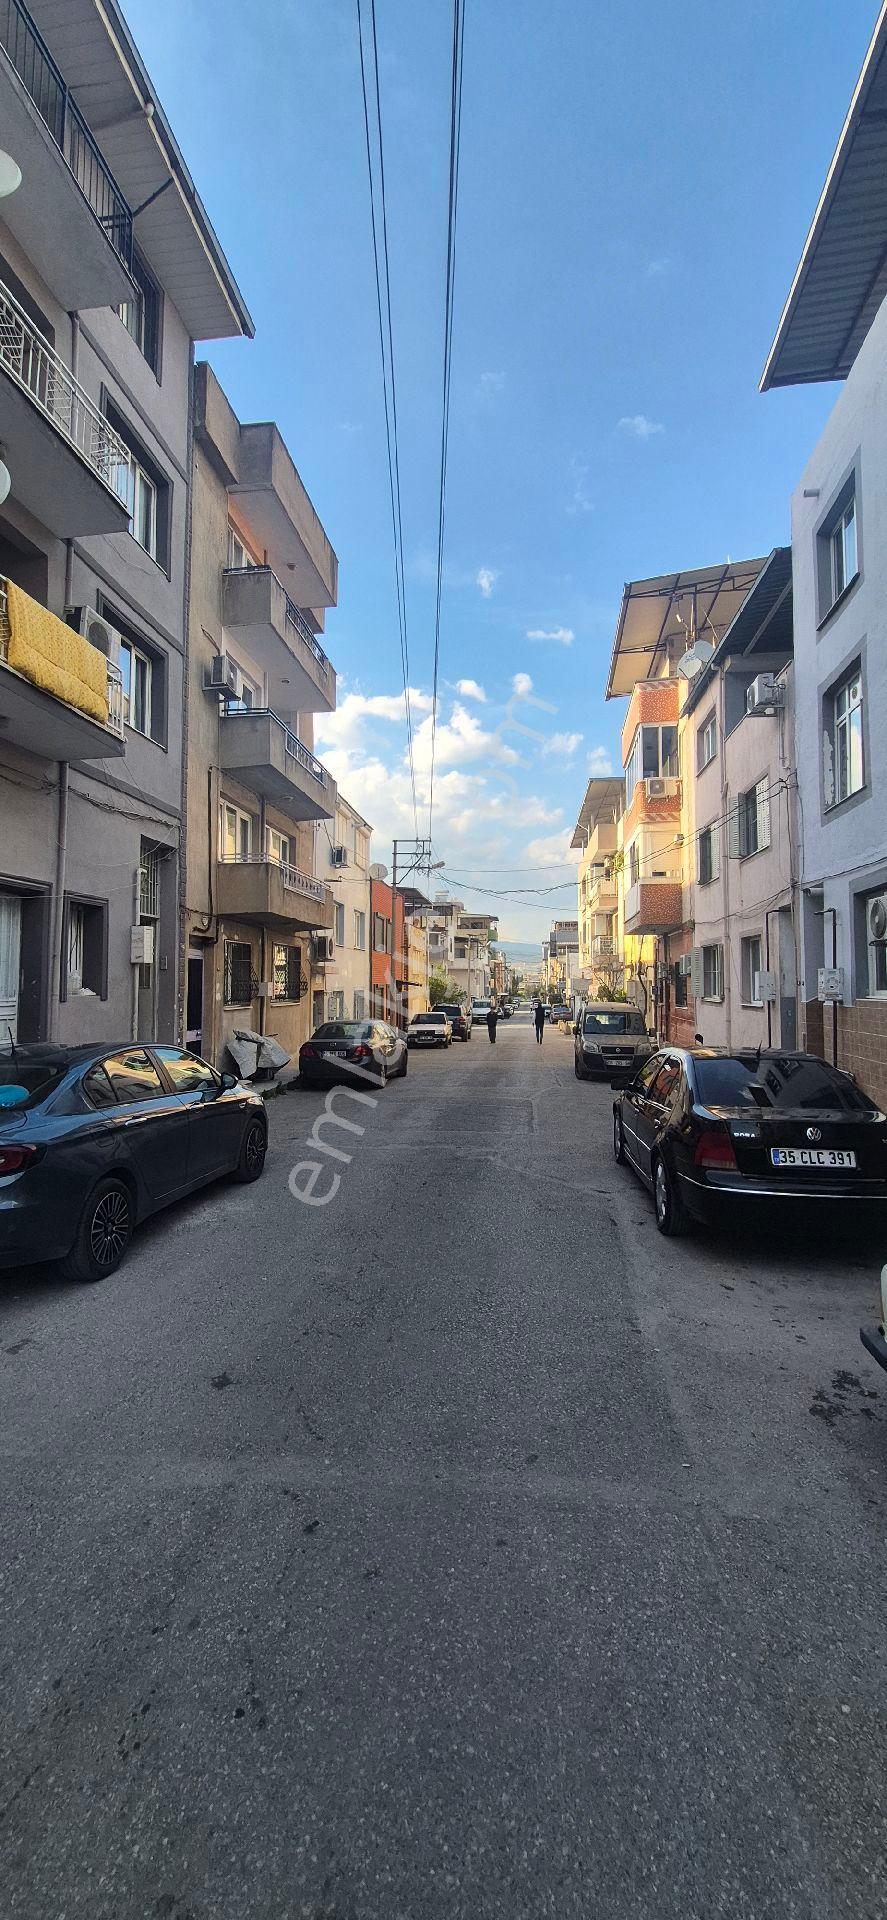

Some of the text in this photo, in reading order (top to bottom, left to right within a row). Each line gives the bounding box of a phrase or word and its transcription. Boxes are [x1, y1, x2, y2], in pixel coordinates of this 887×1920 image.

[780, 1150, 795, 1164] 35
[800, 1151, 825, 1165] CLC
[828, 1152, 852, 1166] 391
